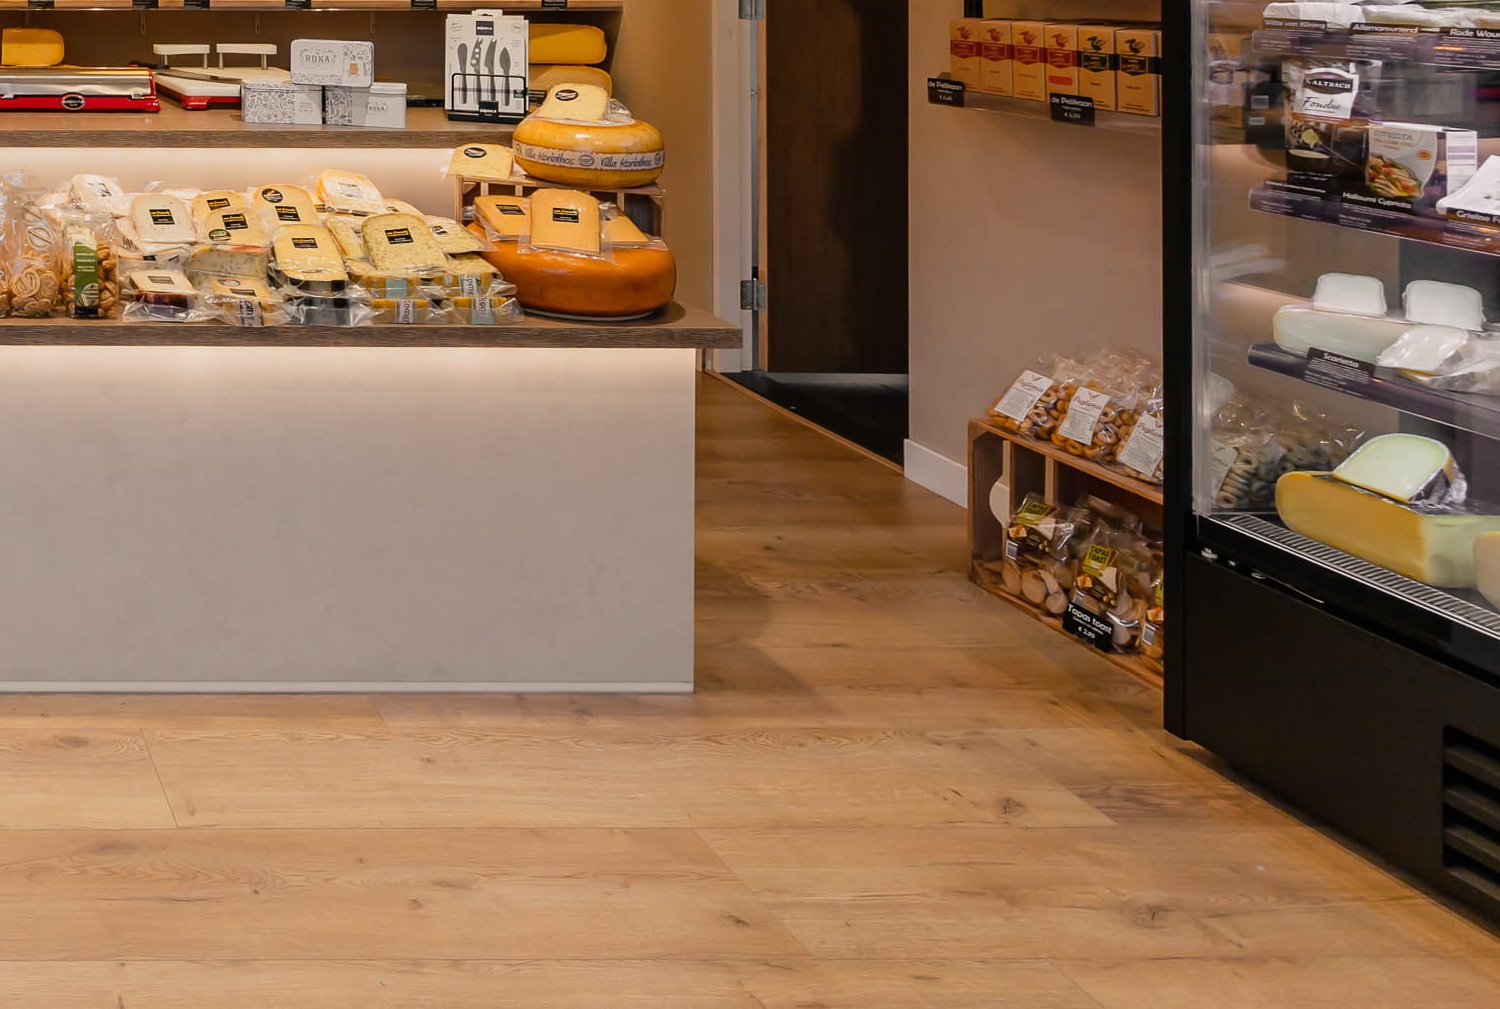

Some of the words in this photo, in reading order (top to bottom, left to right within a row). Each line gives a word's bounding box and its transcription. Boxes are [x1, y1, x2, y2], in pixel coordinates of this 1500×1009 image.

[304, 53, 331, 65] ROKA
[537, 150, 575, 166] Korinthos
[1067, 602, 1091, 623] Tapas
[1091, 617, 1113, 634] toast
